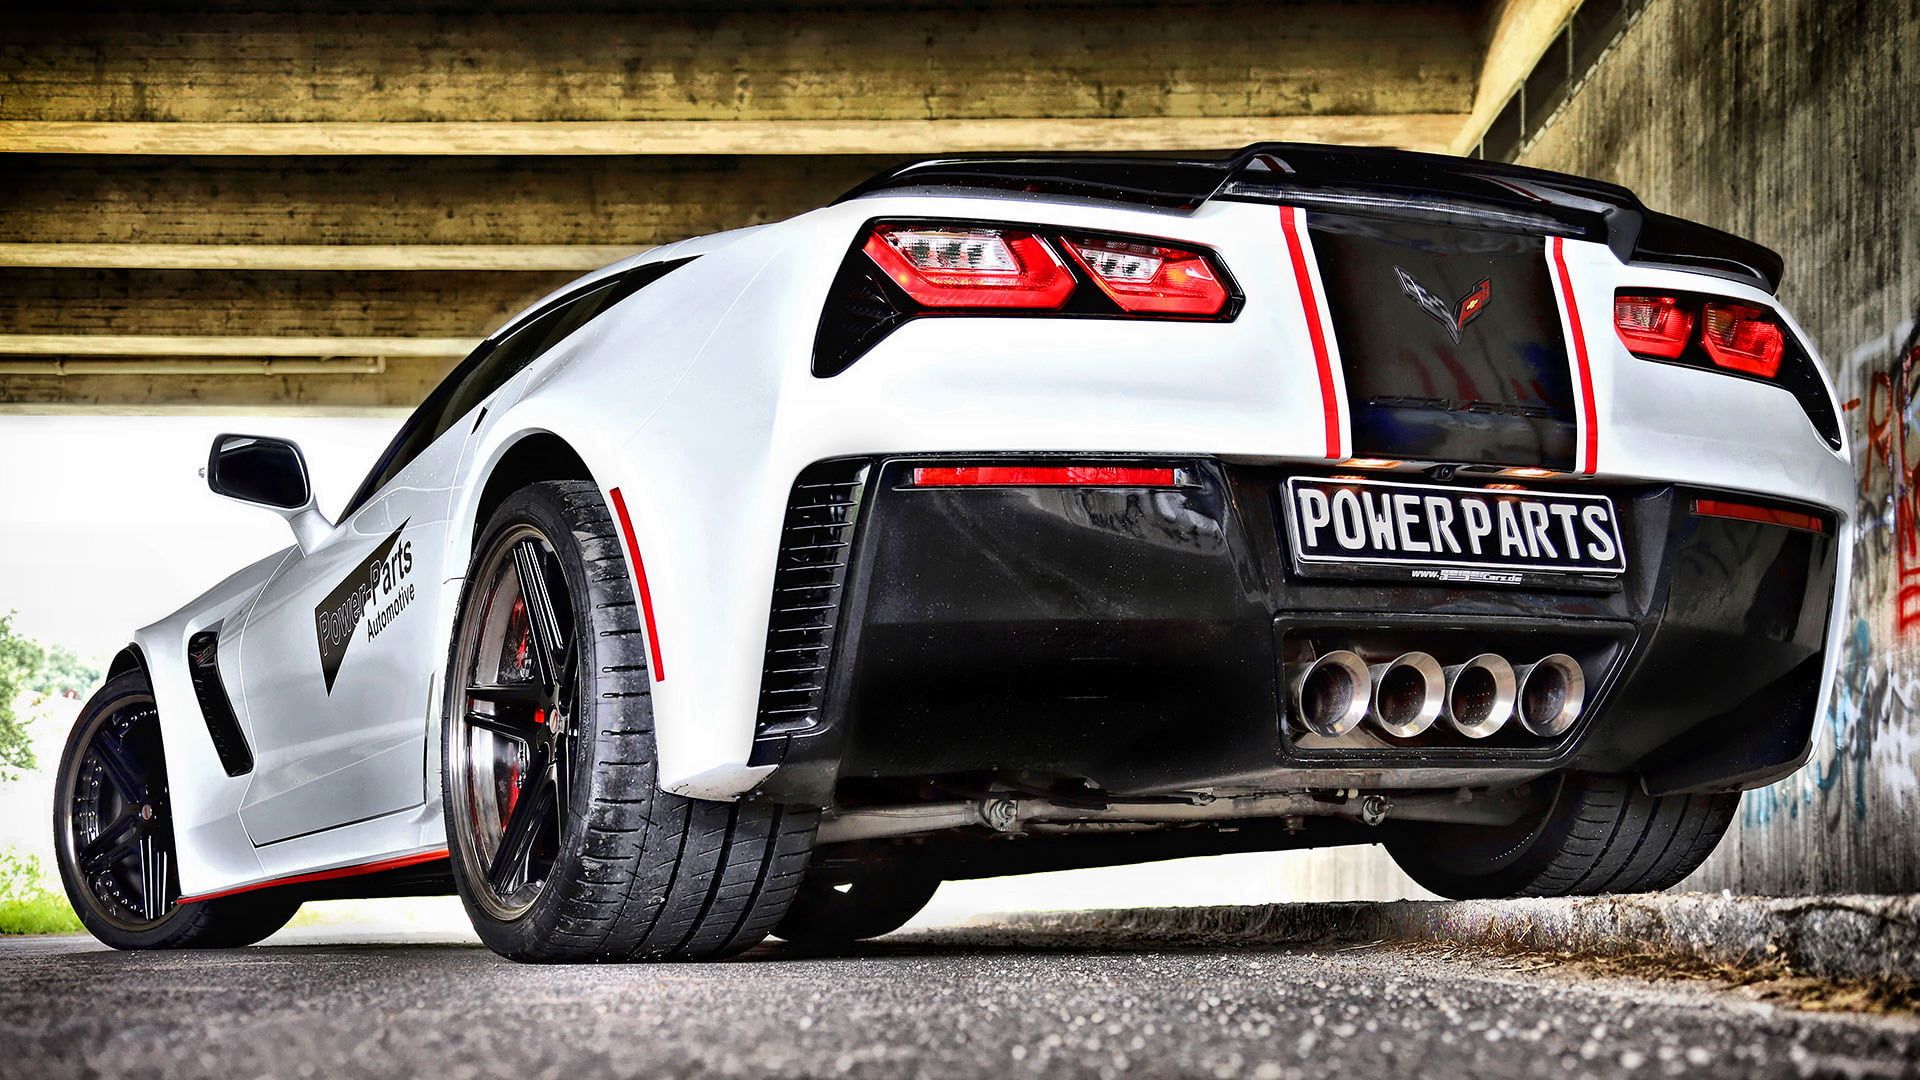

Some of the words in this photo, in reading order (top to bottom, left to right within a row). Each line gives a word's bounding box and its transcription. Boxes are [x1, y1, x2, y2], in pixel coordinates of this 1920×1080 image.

[1297, 488, 1461, 553] POWER
[1461, 498, 1617, 561] PARTS
[318, 540, 414, 657] Power-Parts
[366, 582, 415, 643] Automotive
